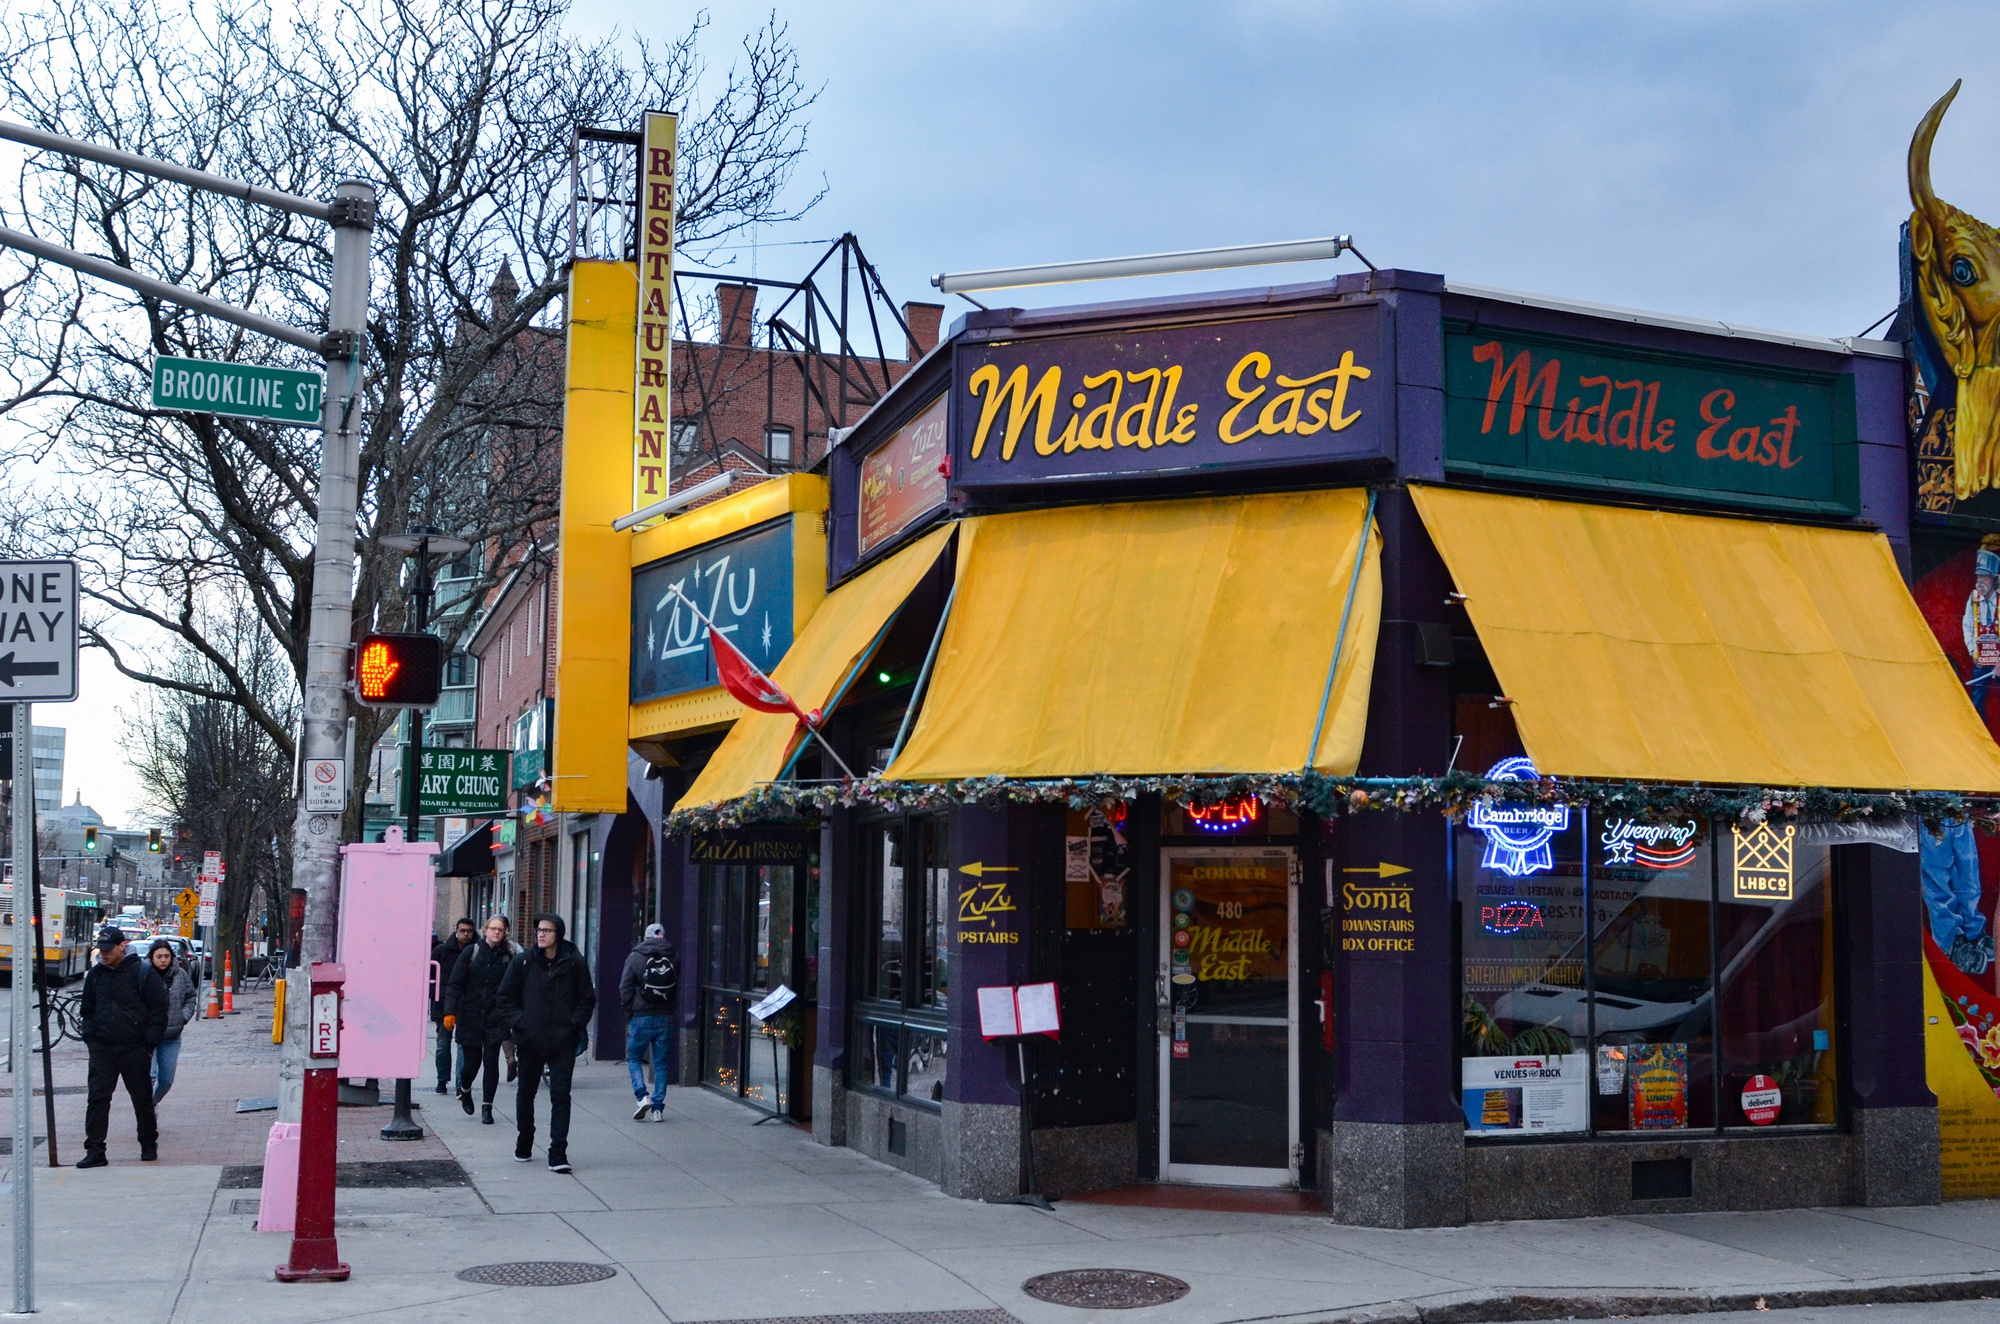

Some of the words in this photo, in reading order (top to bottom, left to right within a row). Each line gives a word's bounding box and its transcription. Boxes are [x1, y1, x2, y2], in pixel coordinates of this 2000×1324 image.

[640, 147, 673, 495] RESTAURANT
[161, 368, 284, 409] BROOKLINE
[295, 382, 318, 412] ST
[969, 364, 1198, 460] Middle
[1218, 350, 1371, 444] East
[1473, 341, 1675, 453] Middle
[1696, 389, 1803, 469] East
[0, 573, 61, 603] NE
[0, 612, 64, 642] AY
[420, 774, 451, 794] ARY
[456, 775, 500, 796] CHUNG
[1480, 808, 1563, 826] Cambridge
[1601, 818, 1697, 847] Yuengling
[753, 850, 801, 859] DANCING
[754, 841, 794, 850] DINING
[1192, 866, 1267, 880] CORNER
[1342, 882, 1414, 914] Sonia
[1217, 901, 1243, 919] 480
[1481, 907, 1544, 927] PIZZA
[1342, 920, 1415, 932] DOWNSTAIRS
[1188, 926, 1272, 953] Middle
[1342, 938, 1365, 951] BOX
[1367, 938, 1415, 951] OFFICE
[1198, 954, 1253, 981] East
[1465, 966, 1542, 985] ENTERTAINMENT
[1544, 966, 1583, 985] NIGHTLY
[1494, 1070, 1527, 1079] VENUES
[1539, 1068, 1562, 1078] ROCK
[1748, 1096, 1775, 1107] delivers!
[1643, 1118, 1676, 1126] BRUNCH
